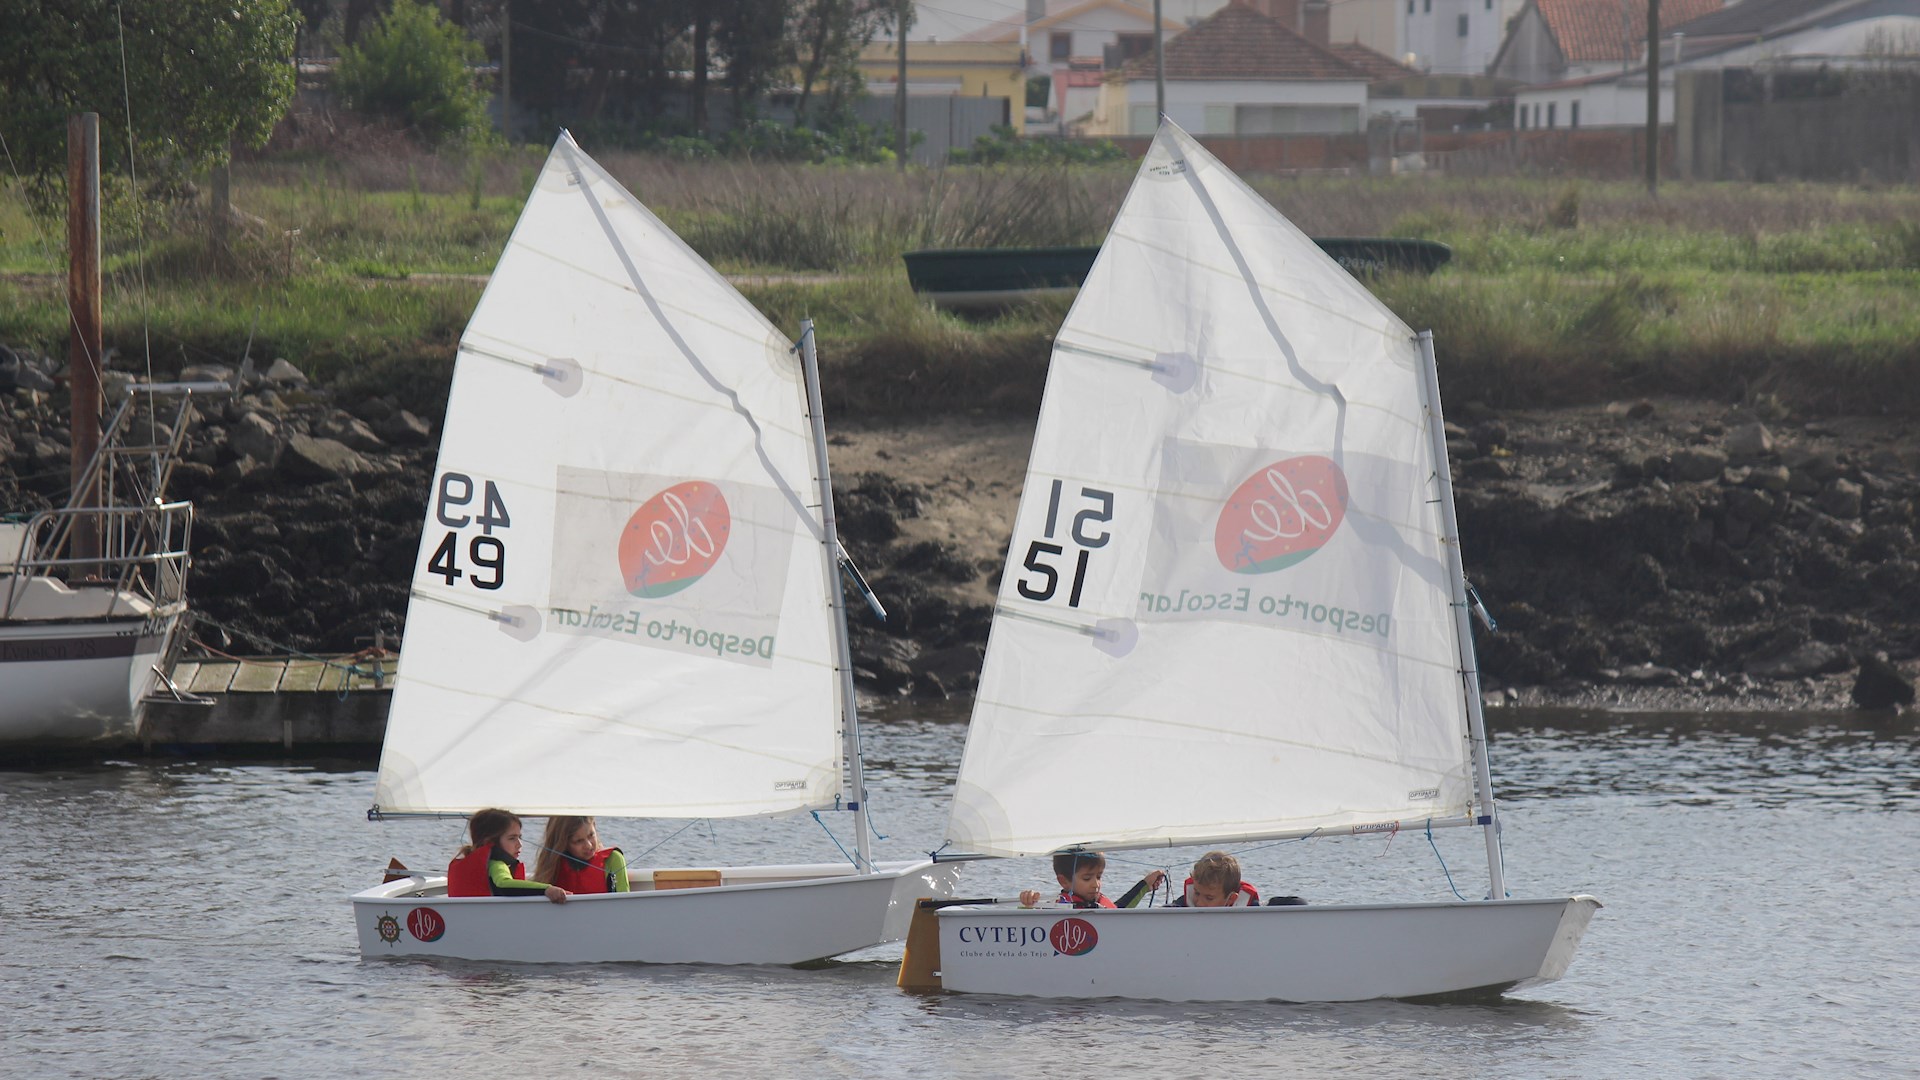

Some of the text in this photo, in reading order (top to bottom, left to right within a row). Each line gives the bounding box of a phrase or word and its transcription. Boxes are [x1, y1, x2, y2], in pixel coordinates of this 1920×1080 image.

[427, 531, 506, 590] 49
[1016, 540, 1089, 608] 51
[959, 926, 1046, 947] CVTEJO
[1030, 950, 1048, 958] Tejo
